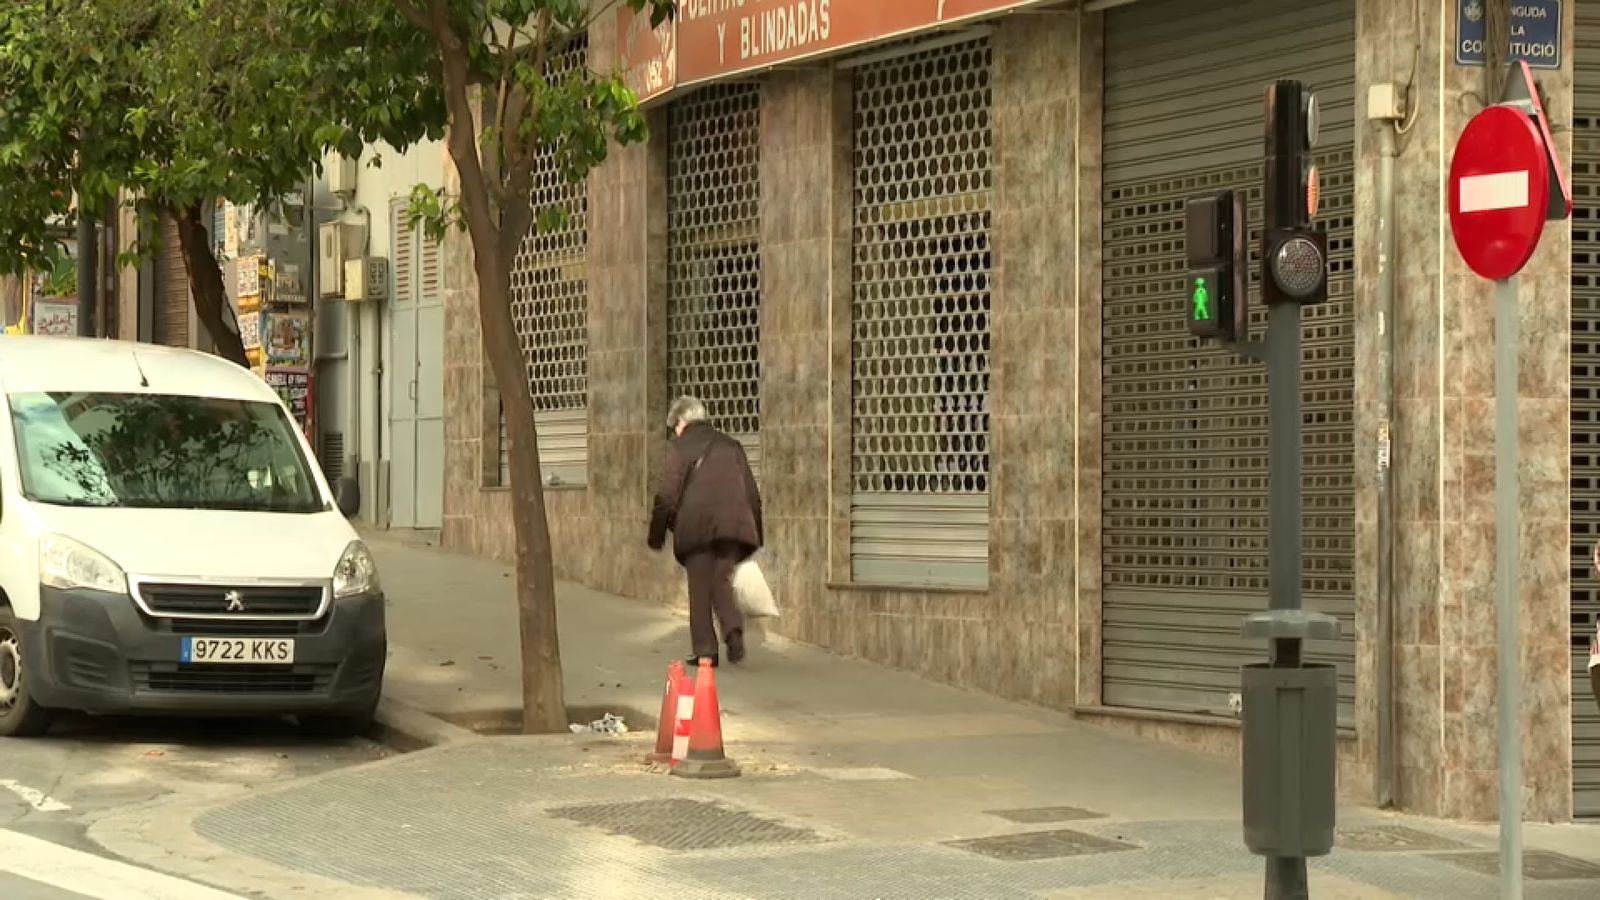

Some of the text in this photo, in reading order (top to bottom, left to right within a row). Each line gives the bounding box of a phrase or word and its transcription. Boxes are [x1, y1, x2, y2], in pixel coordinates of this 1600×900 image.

[1510, 6, 1547, 18] NGUDA
[717, 22, 726, 65] Y
[741, 0, 830, 60] BLINDADAS
[1511, 25, 1526, 36] LA
[1461, 39, 1555, 57] COITUCIÓ
[196, 640, 288, 660] 9722 KKS
